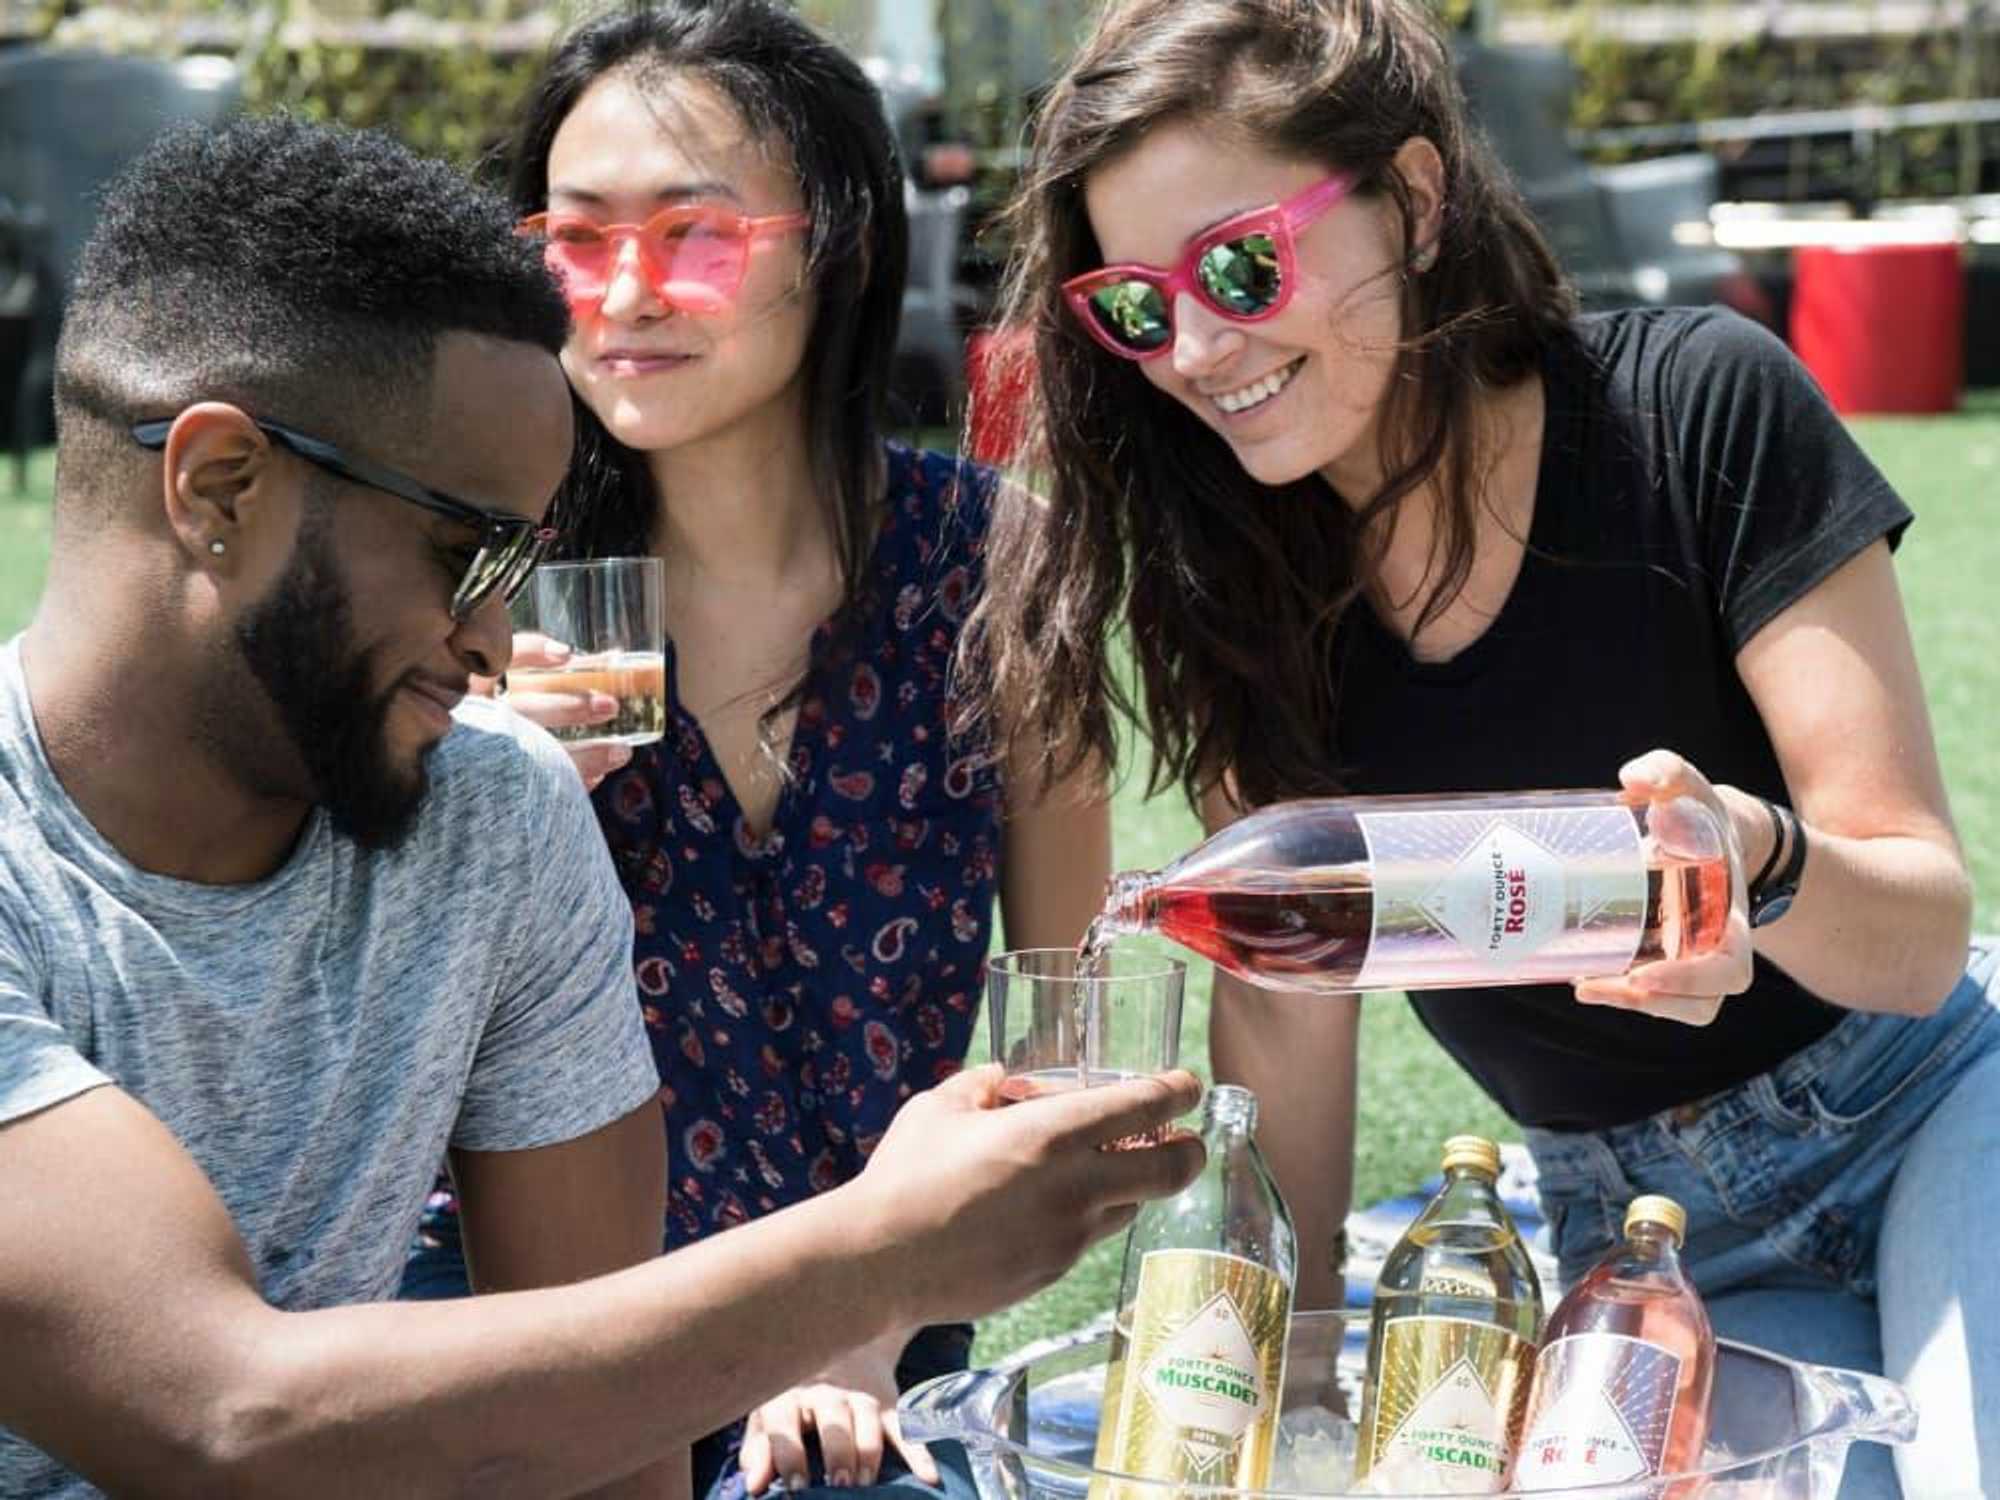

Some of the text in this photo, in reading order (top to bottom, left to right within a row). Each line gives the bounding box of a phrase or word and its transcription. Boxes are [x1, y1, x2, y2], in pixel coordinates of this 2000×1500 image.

[1489, 852, 1505, 950] FORTY OUNCE
[1156, 1368, 1259, 1407] MUSCADET
[1168, 1357, 1255, 1385] FORTY OUNCE
[1416, 1444, 1508, 1476] SCADT
